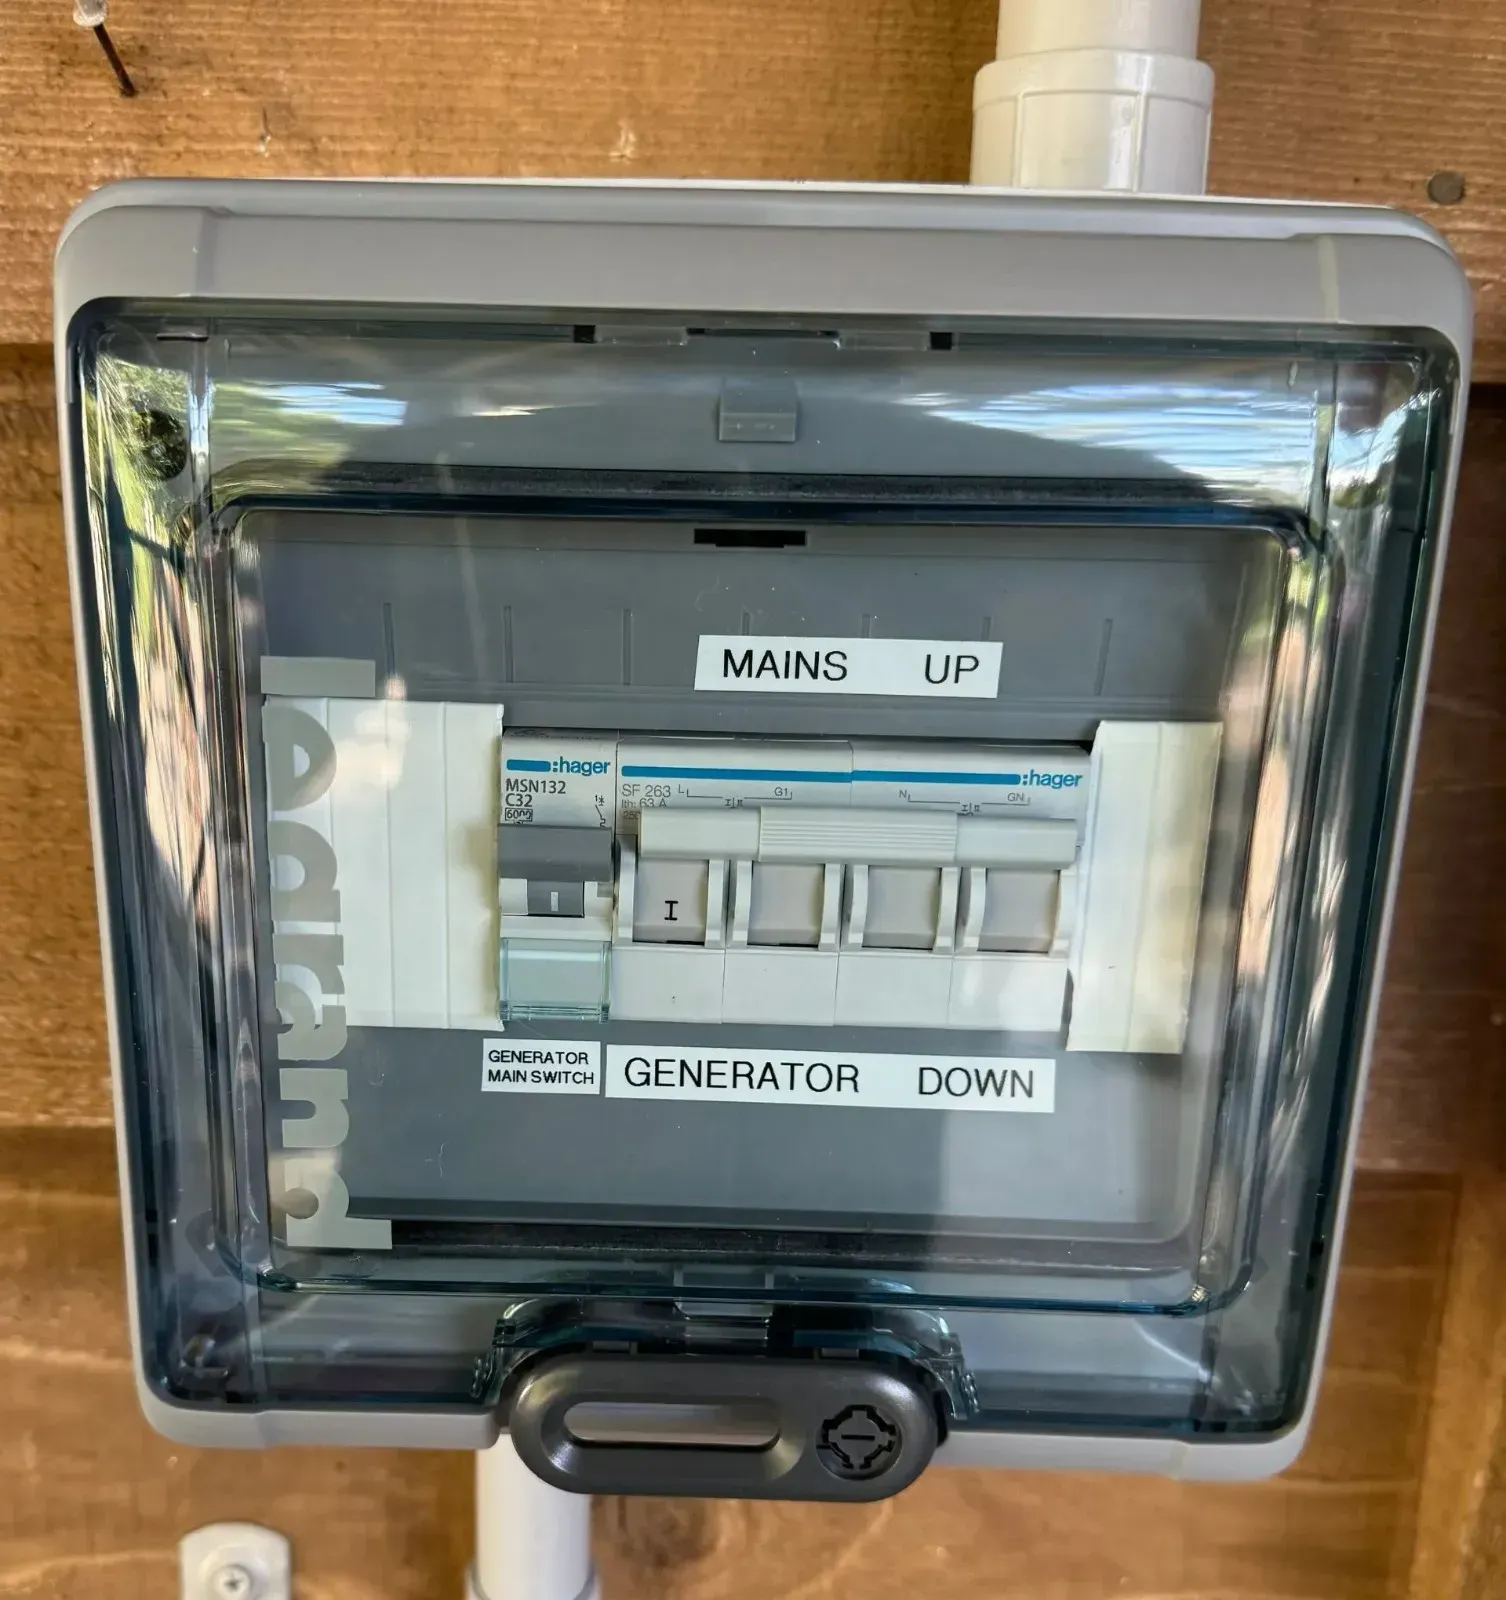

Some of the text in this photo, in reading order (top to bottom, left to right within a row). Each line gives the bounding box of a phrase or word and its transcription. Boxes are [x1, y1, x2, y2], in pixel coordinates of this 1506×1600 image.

[723, 648, 980, 684] MAINS UP
[505, 778, 567, 794] MSN132
[621, 784, 671, 798] SF 263
[774, 786, 788, 797] G1
[505, 793, 533, 808] C32
[899, 789, 907, 799] N
[1007, 792, 1024, 802] GN
[639, 797, 655, 809] 63
[658, 797, 668, 809] A
[488, 1050, 590, 1065] GENERATOR
[488, 1069, 595, 1085] MAIN SWITCH
[624, 1057, 1034, 1098] GENERATOR DOWN
